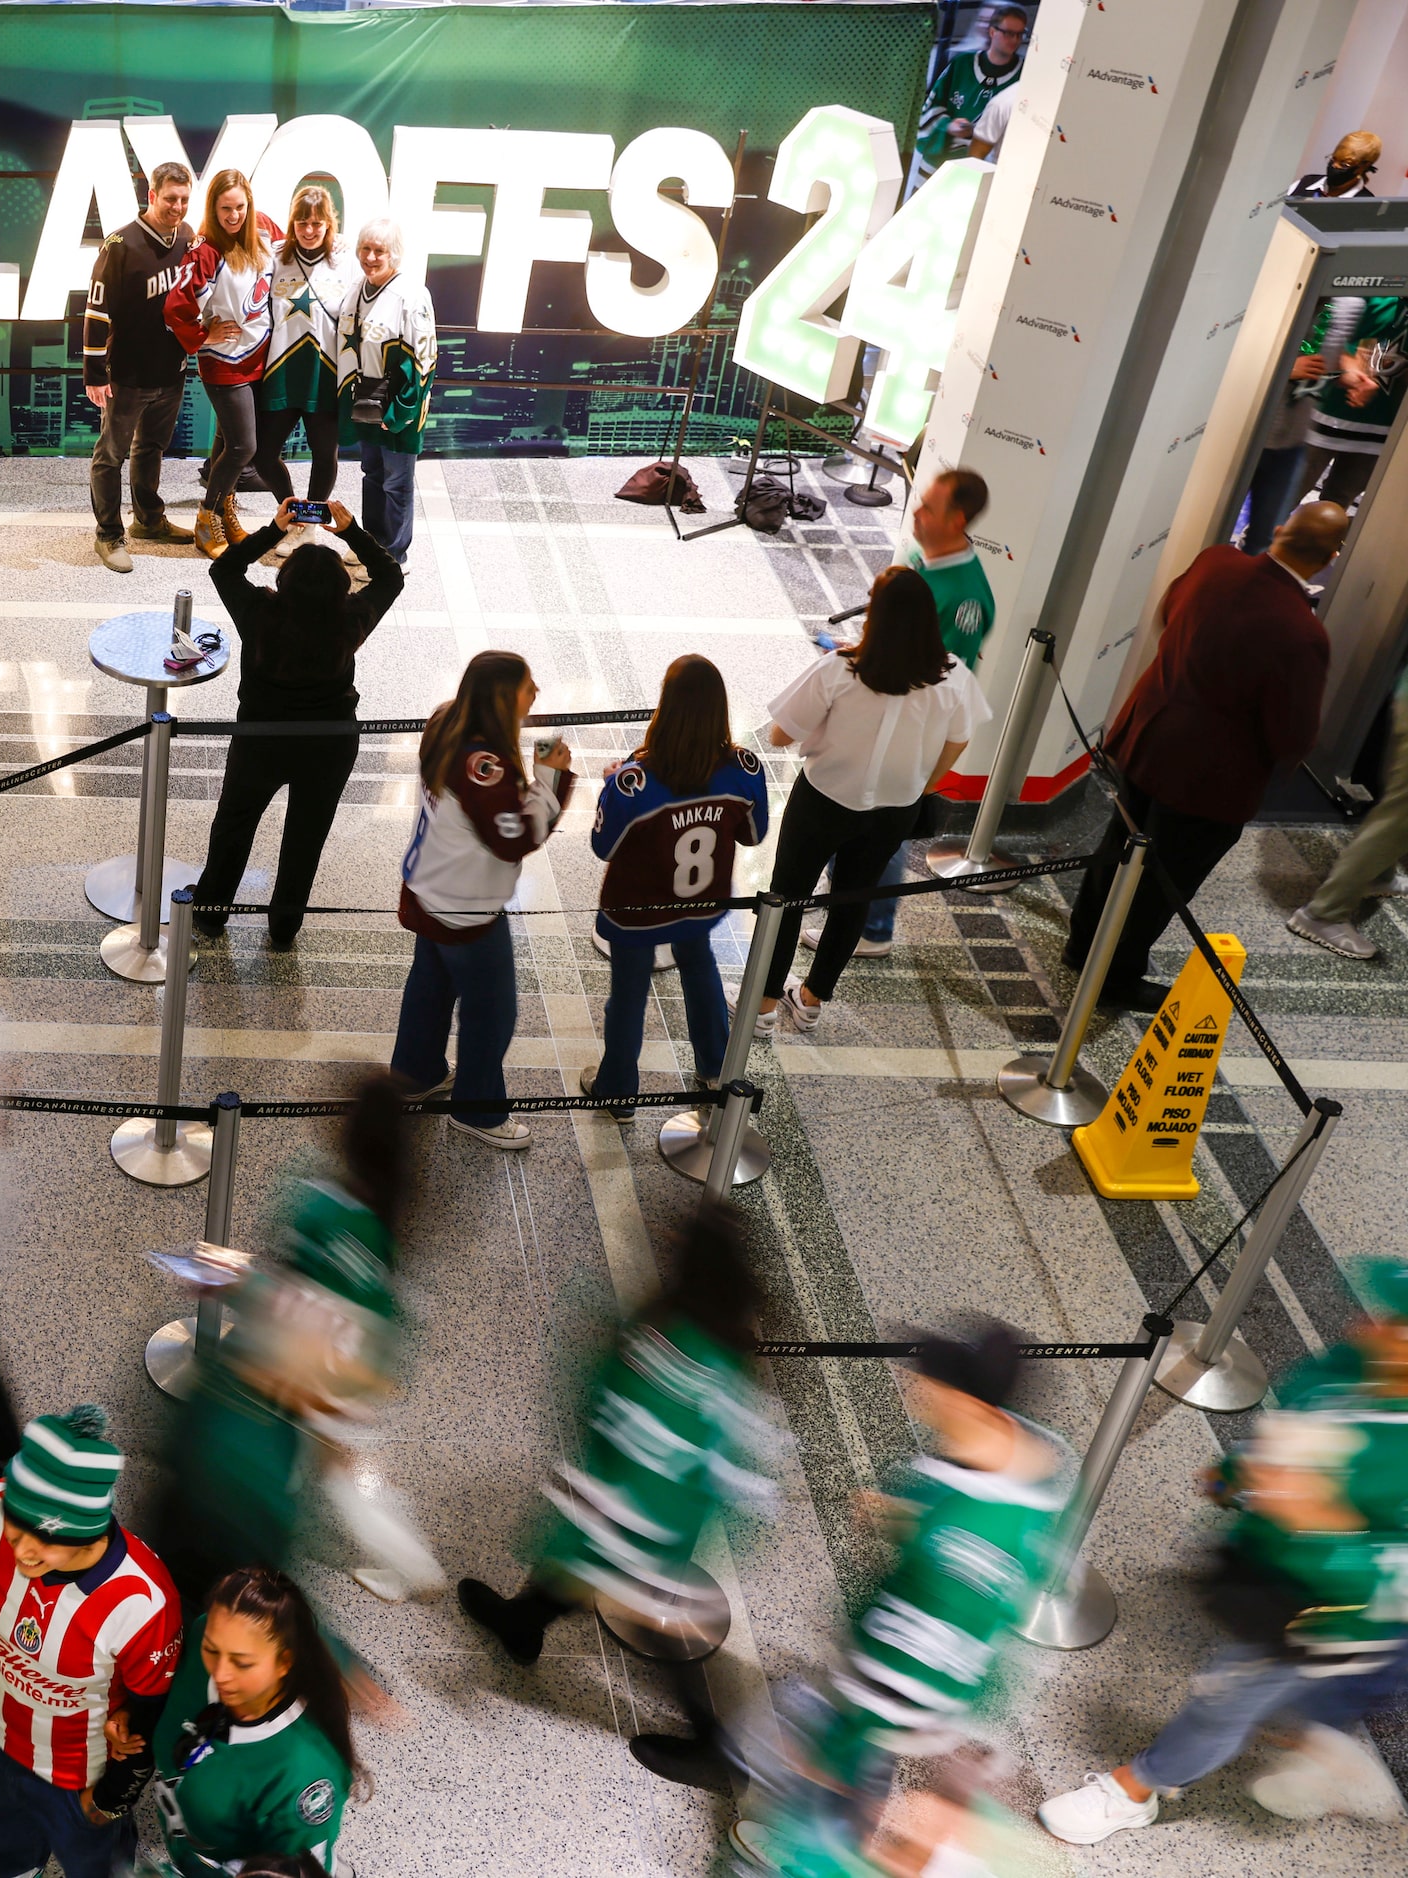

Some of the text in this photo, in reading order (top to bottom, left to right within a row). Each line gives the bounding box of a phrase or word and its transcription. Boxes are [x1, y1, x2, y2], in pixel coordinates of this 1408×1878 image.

[1087, 69, 1145, 90] AAdvantage
[1050, 196, 1105, 218] AAdvantage
[146, 267, 179, 300] DAL
[733, 105, 995, 450] 24
[1332, 276, 1384, 287] GARRETT
[1016, 315, 1068, 337] AAdvantage
[984, 427, 1034, 450] AAdvantage
[671, 806, 724, 831] MAKAR
[672, 825, 719, 898] 8
[949, 859, 1083, 887] AMERICANAIRLINESCENTER
[1183, 1033, 1220, 1043] CAUTION
[1143, 1048, 1158, 1072] WET
[1178, 1048, 1214, 1059] CUIDADO
[1134, 1058, 1154, 1090] FLOOR
[1176, 1072, 1204, 1083] WET
[511, 1095, 675, 1110] AMERICANAIRLINESCENTER
[1126, 1082, 1141, 1107] PISO
[1164, 1086, 1205, 1097] FLOOR
[1115, 1089, 1138, 1127] MOJADO
[1161, 1108, 1191, 1119] PISO
[1146, 1122, 1198, 1133] MOJADO
